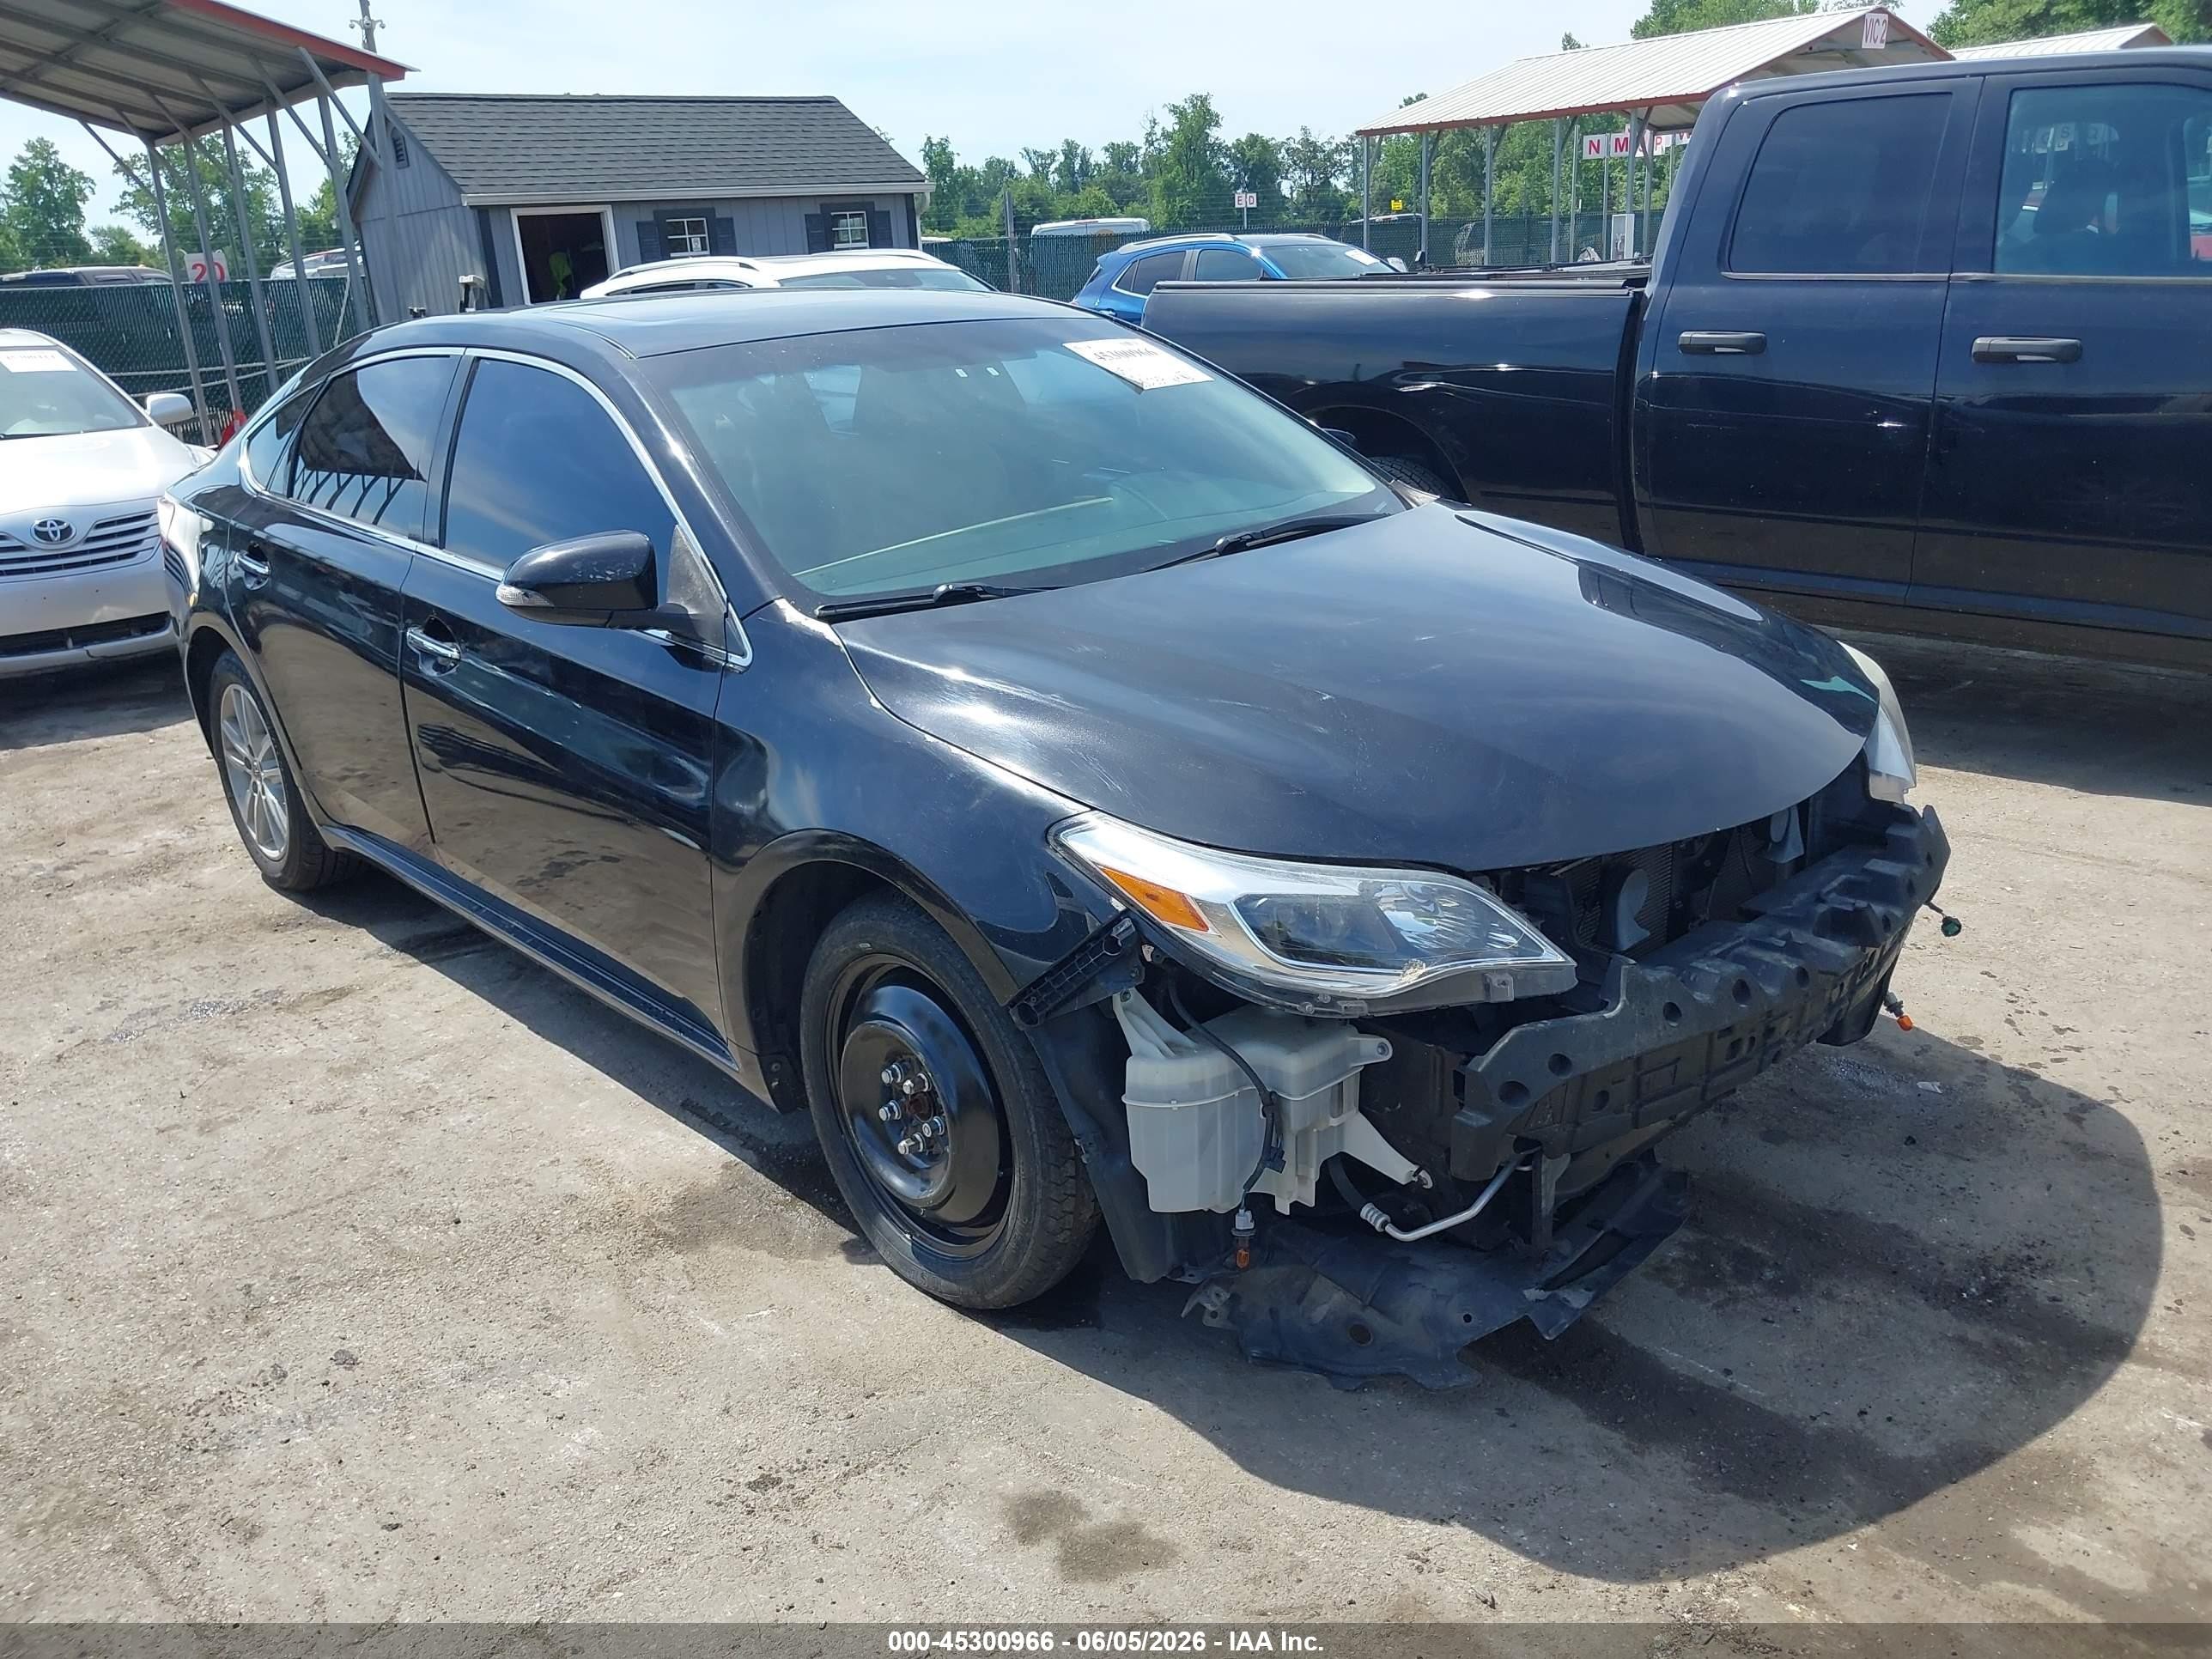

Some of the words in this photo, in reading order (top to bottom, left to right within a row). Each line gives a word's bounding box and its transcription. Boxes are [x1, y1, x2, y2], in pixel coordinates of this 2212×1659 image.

[1864, 18, 1881, 45] VIC
[1880, 19, 1887, 44] 2
[1588, 139, 1601, 155] N
[1613, 137, 1629, 153] M
[1237, 196, 1243, 205] E
[1249, 195, 1255, 205] D
